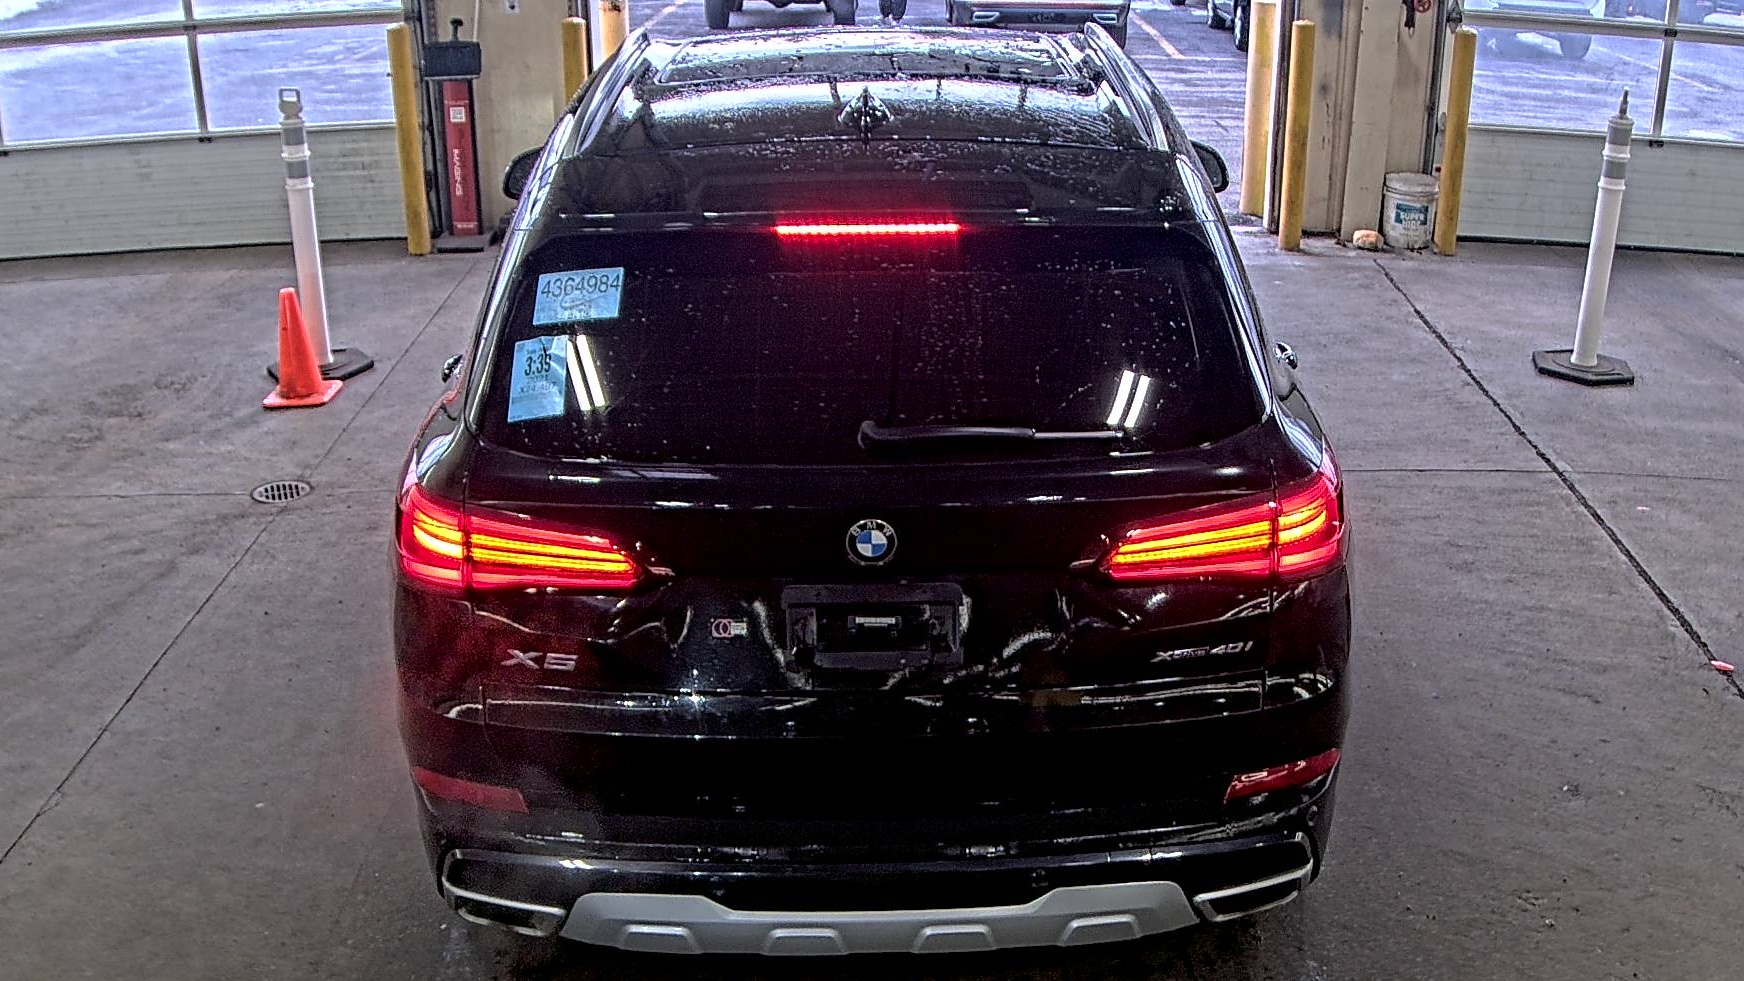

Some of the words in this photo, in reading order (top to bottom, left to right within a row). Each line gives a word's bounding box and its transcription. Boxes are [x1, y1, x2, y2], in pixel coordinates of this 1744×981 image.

[541, 273, 620, 298] 4364984
[524, 353, 552, 377] 3:35
[500, 648, 578, 672] X5
